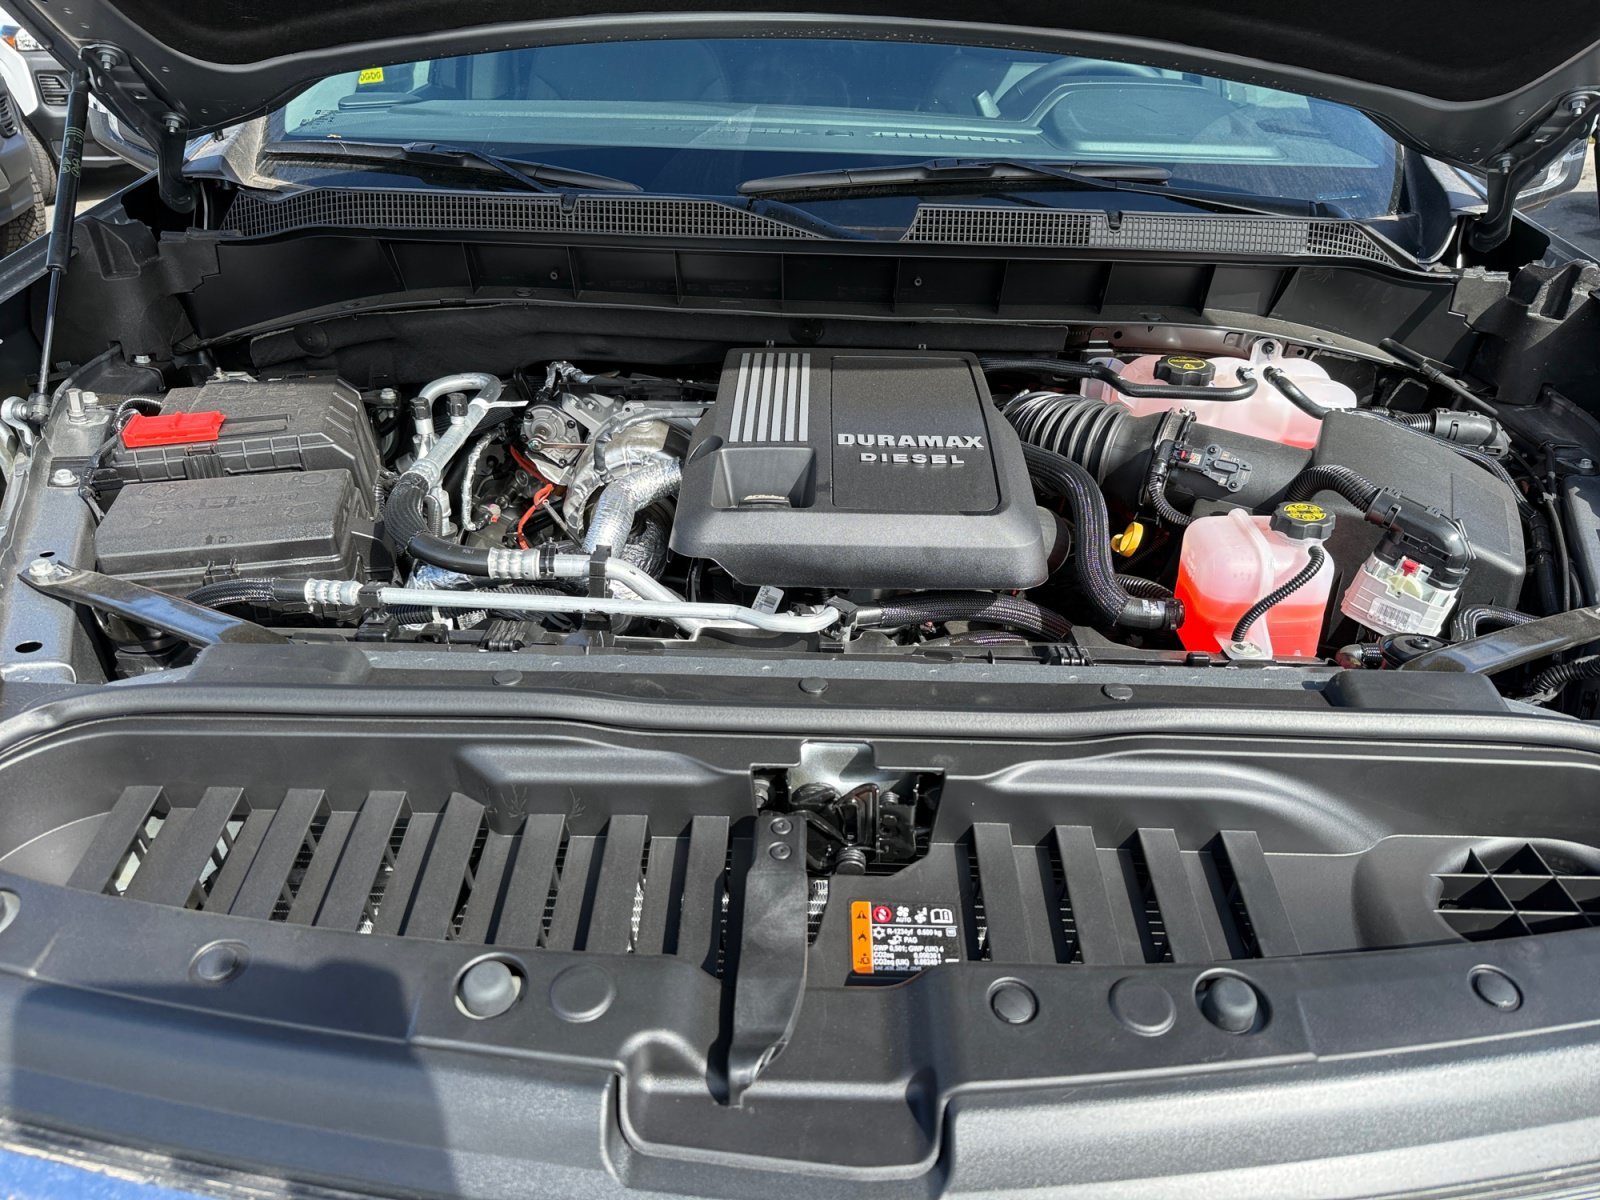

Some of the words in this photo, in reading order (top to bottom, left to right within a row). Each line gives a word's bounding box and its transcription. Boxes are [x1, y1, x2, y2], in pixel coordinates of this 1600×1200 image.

[837, 433, 985, 449] DURAMAX
[859, 452, 965, 465] DIESEL
[934, 929, 943, 937] kg
